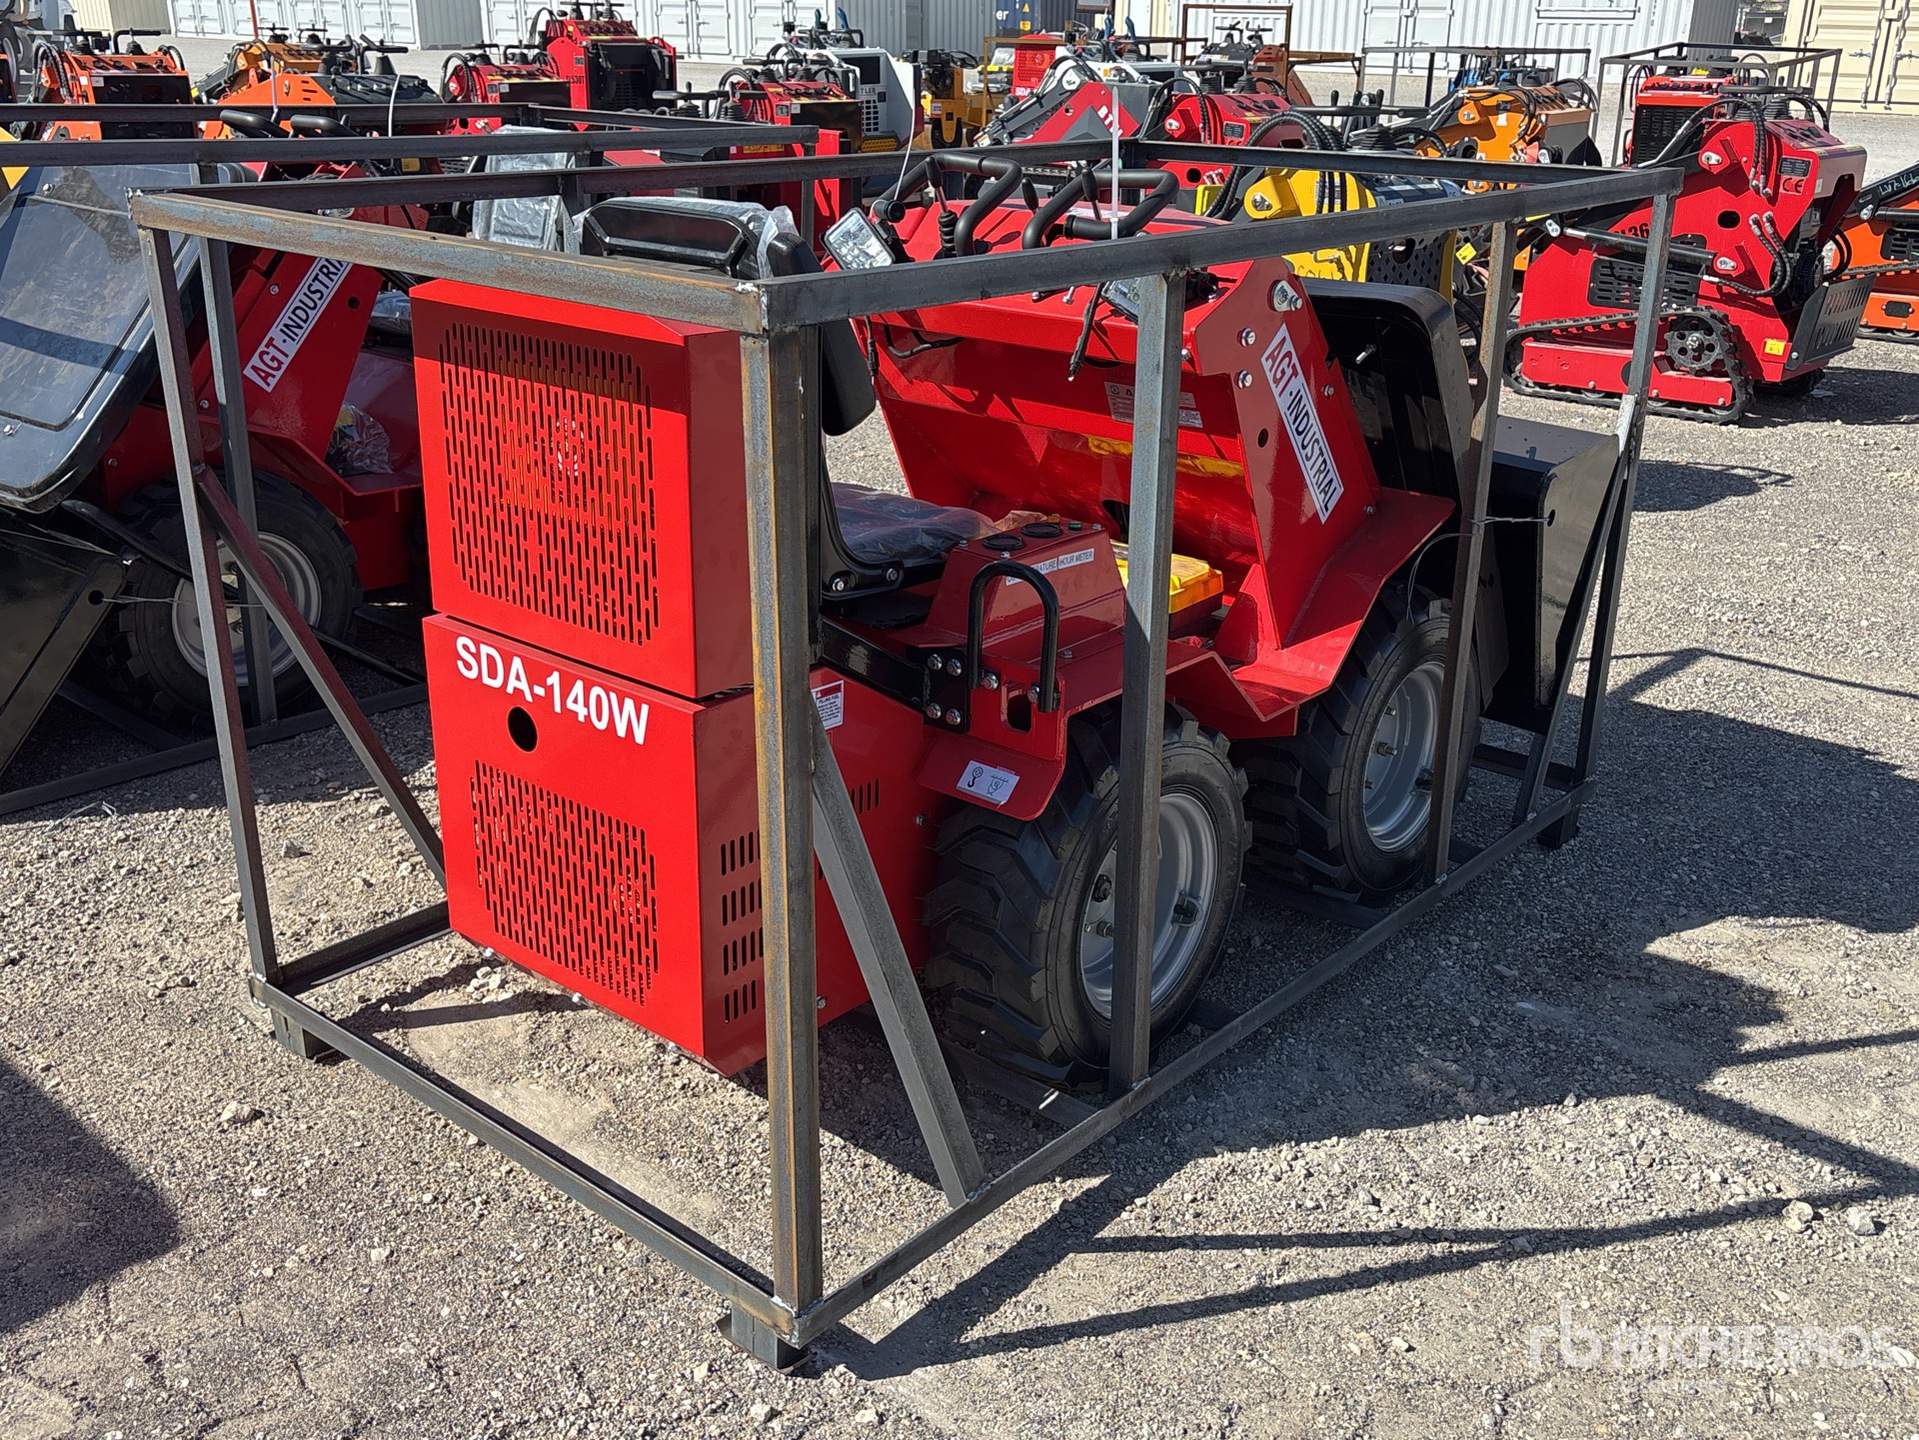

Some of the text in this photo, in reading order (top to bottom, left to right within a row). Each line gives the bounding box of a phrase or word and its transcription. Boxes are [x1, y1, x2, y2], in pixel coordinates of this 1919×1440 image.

[251, 337, 289, 387] AGT
[1265, 335, 1337, 513] AGT INDUSTRIAL
[1060, 555, 1074, 566] HOUR
[456, 636, 649, 745] SDA-140W
